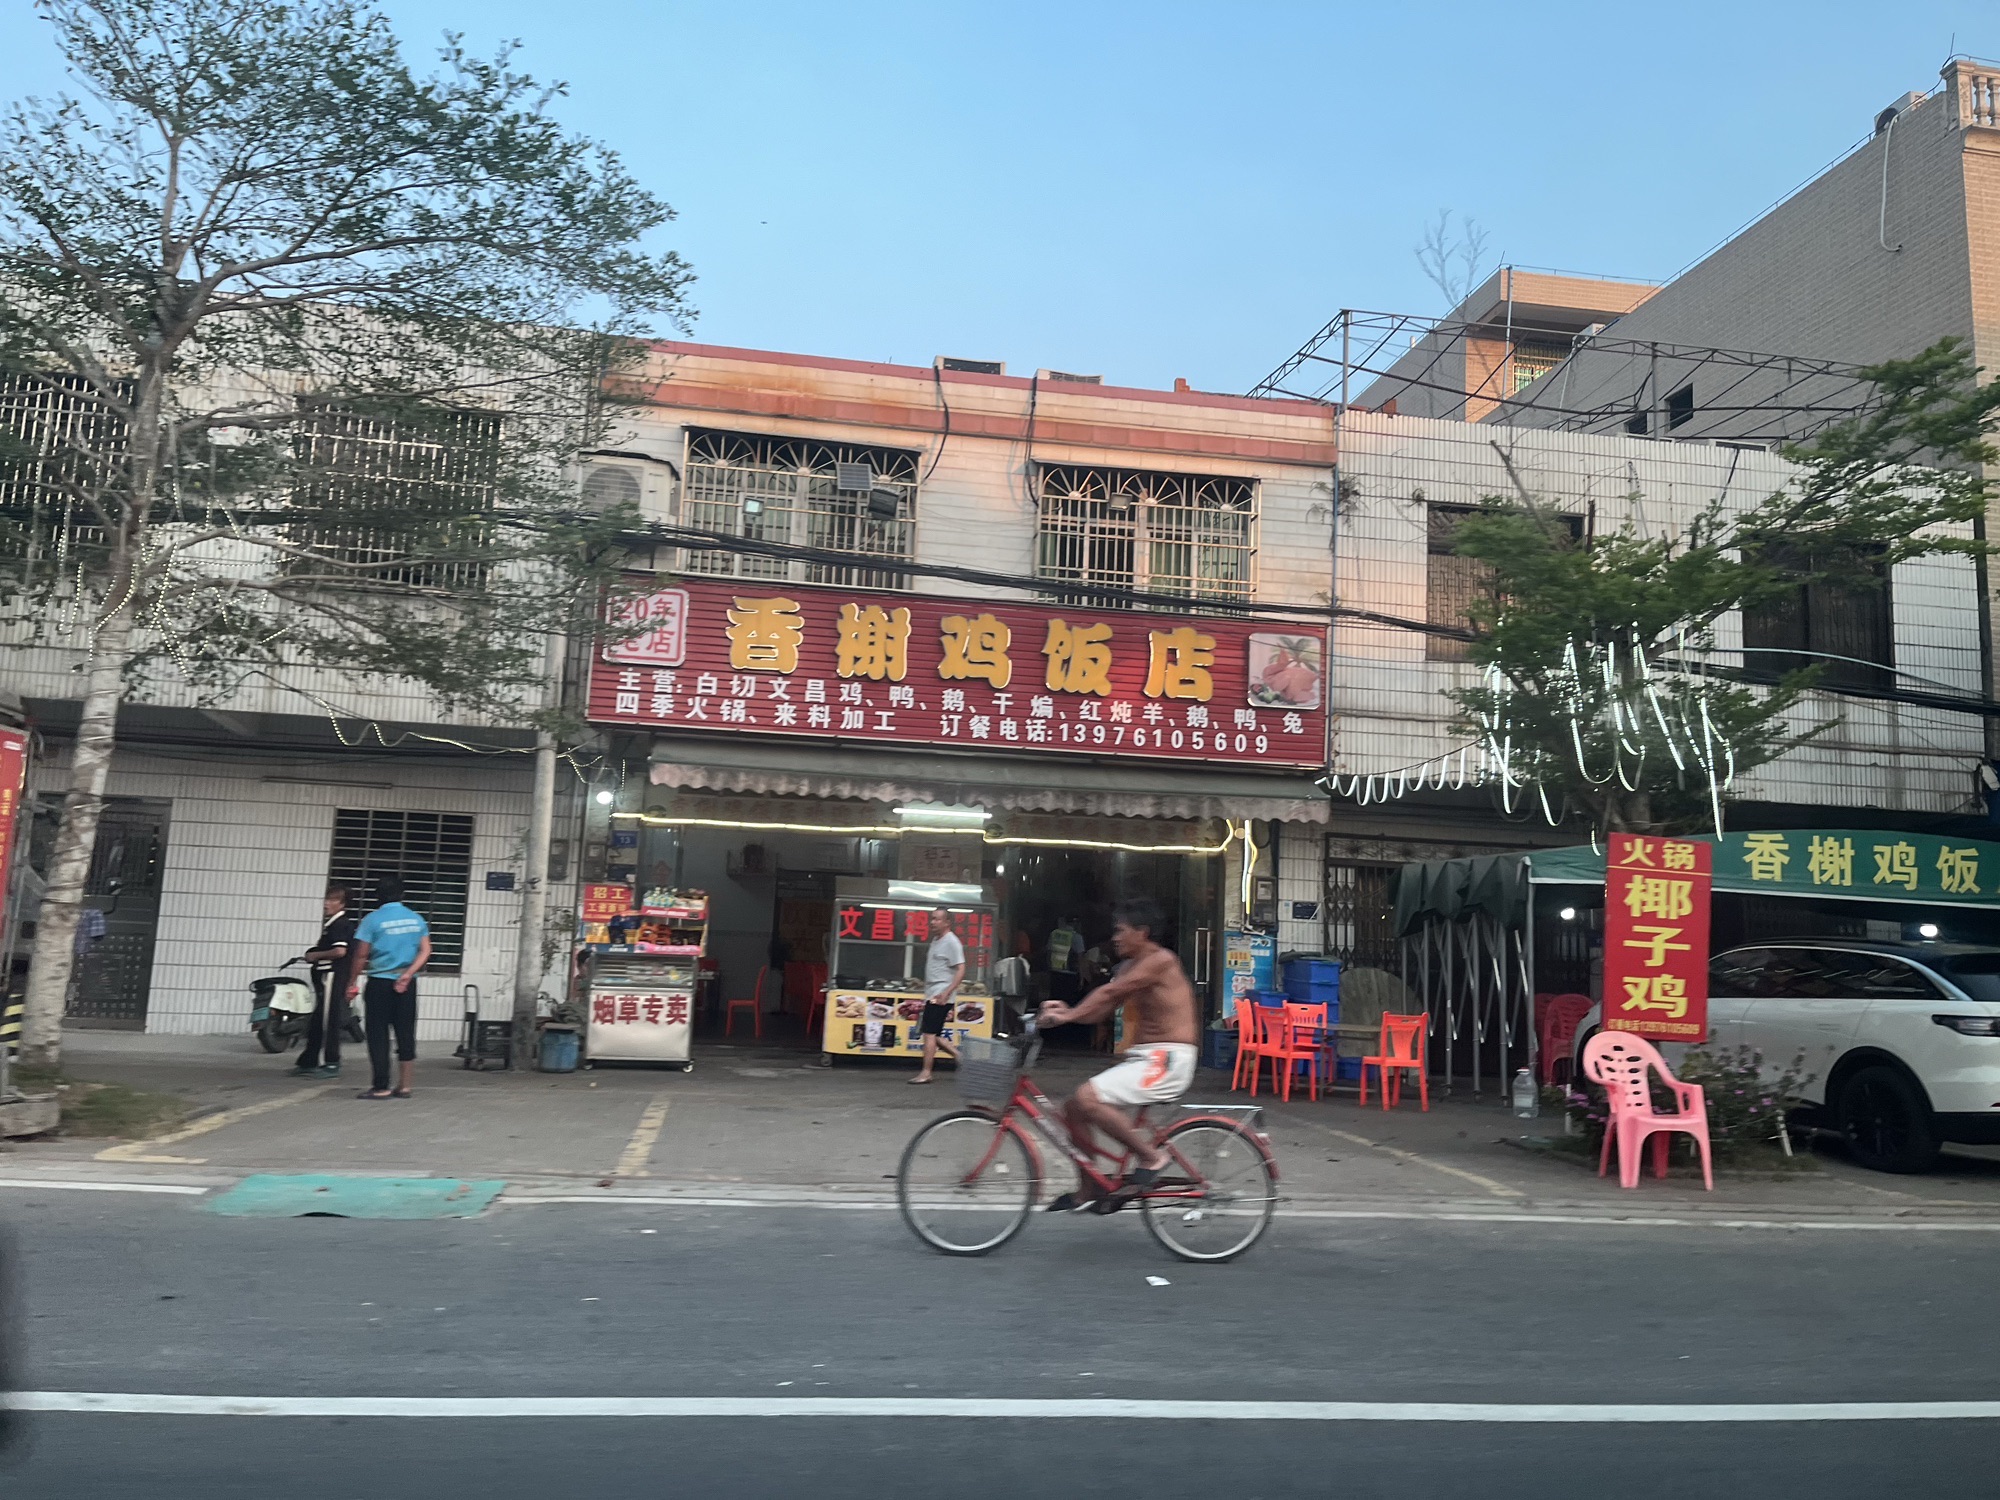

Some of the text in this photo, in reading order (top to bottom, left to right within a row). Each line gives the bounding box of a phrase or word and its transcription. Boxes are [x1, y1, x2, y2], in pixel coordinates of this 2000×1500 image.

[725, 596, 1217, 703] 香榭鸡饭店
[1620, 838, 1695, 870] 火锅
[1743, 833, 2000, 894] 香榭鸡饭
[592, 886, 625, 899] 招工
[839, 906, 929, 941] 文昌鸡
[1620, 875, 1693, 1018] 椰子鸡
[593, 994, 689, 1025] 烟草专卖
